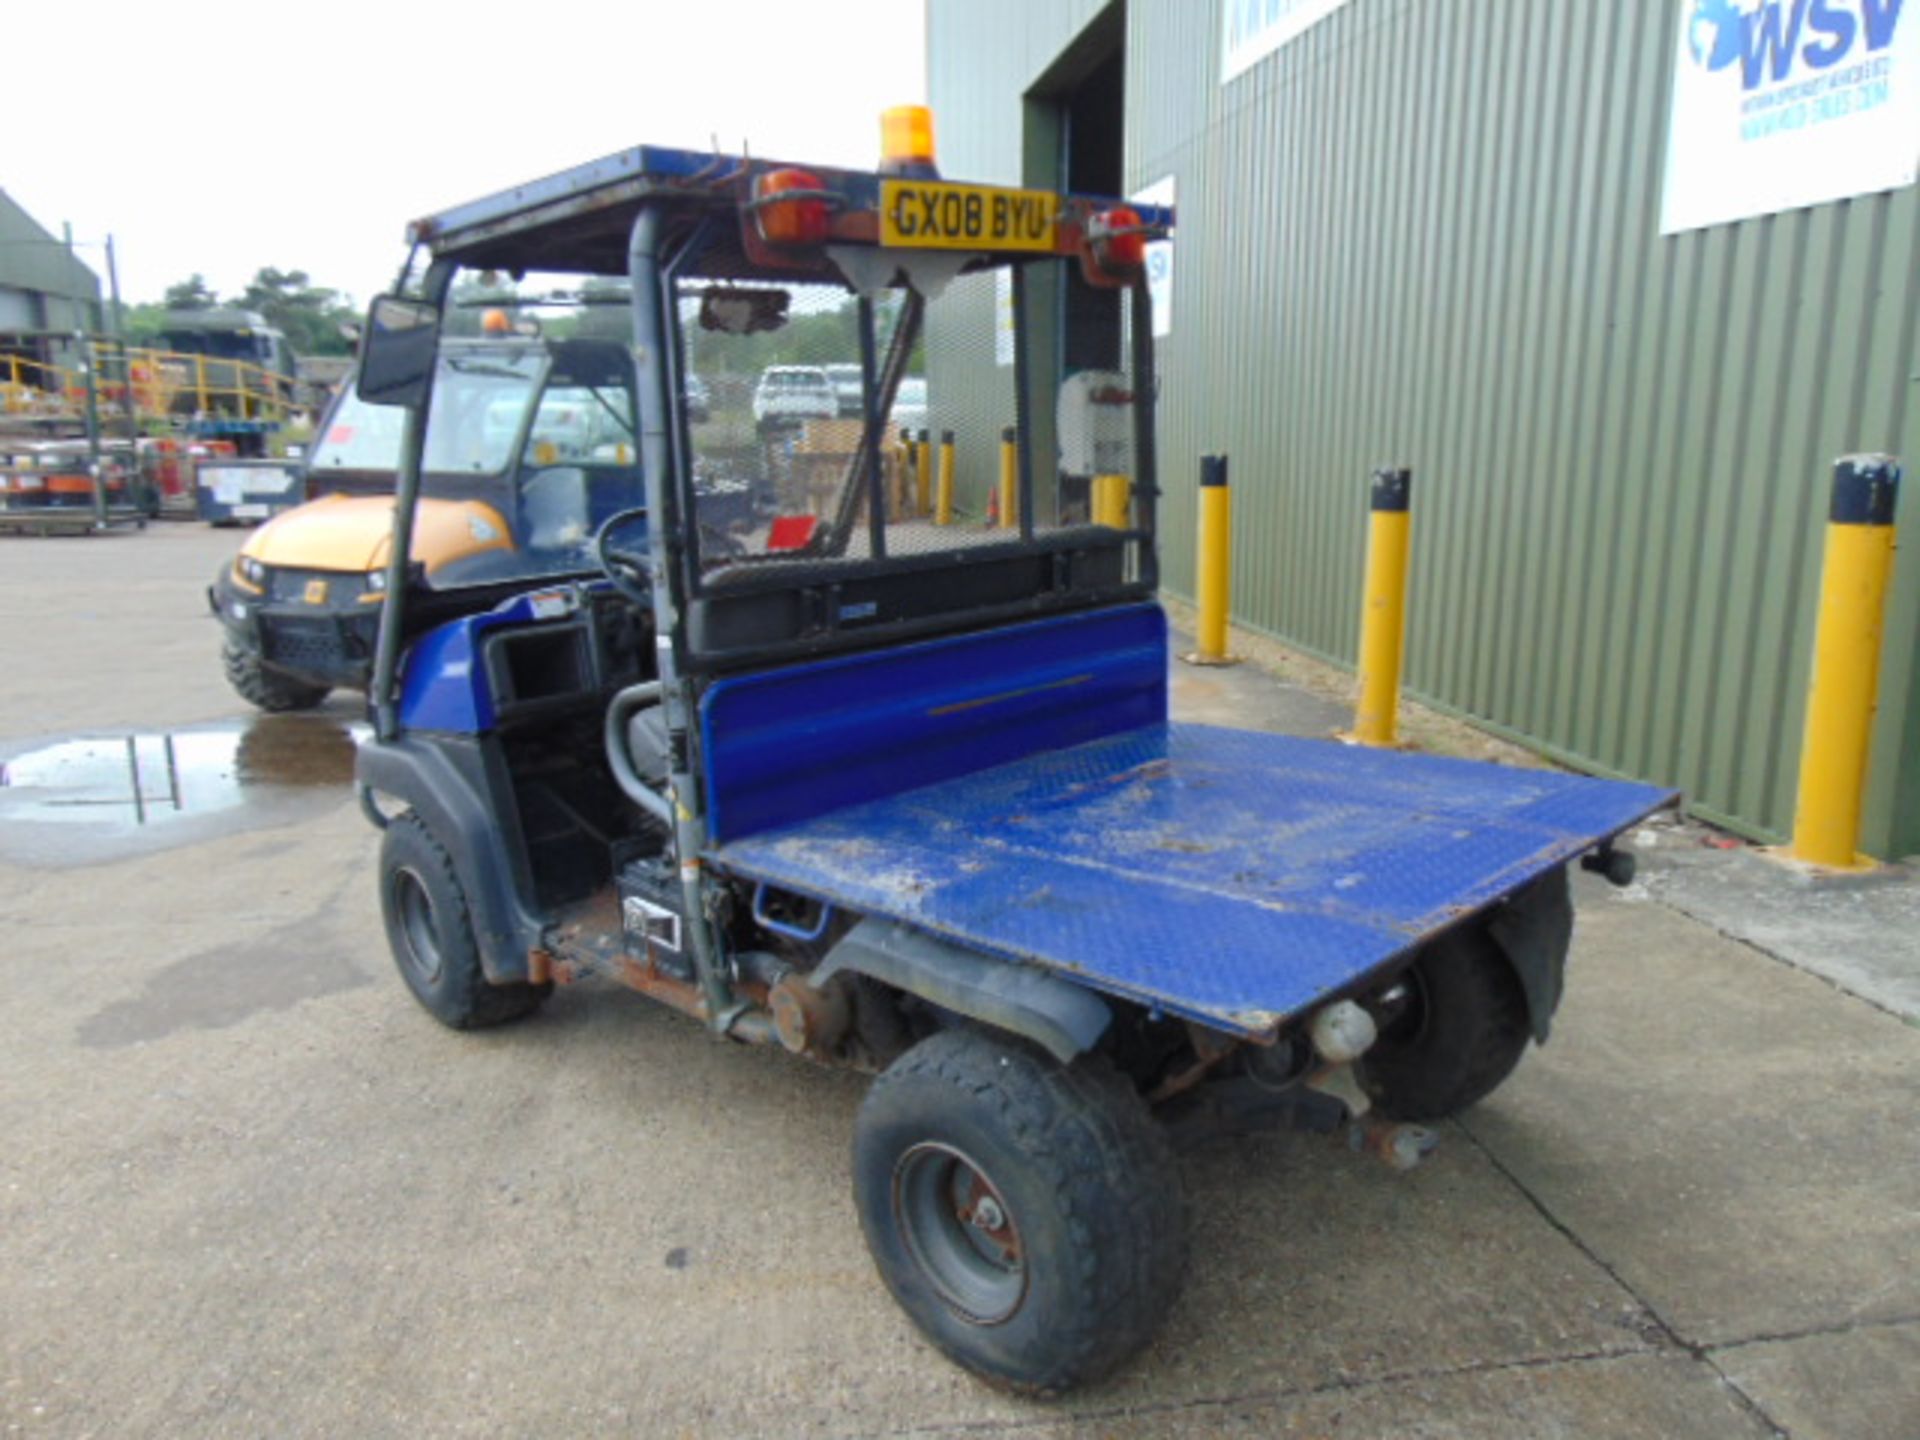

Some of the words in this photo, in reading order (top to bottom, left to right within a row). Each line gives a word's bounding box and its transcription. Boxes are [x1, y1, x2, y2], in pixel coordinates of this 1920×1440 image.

[1739, 0, 1903, 90] WSV
[895, 189, 983, 237] GX08
[992, 195, 1047, 239] BYU
